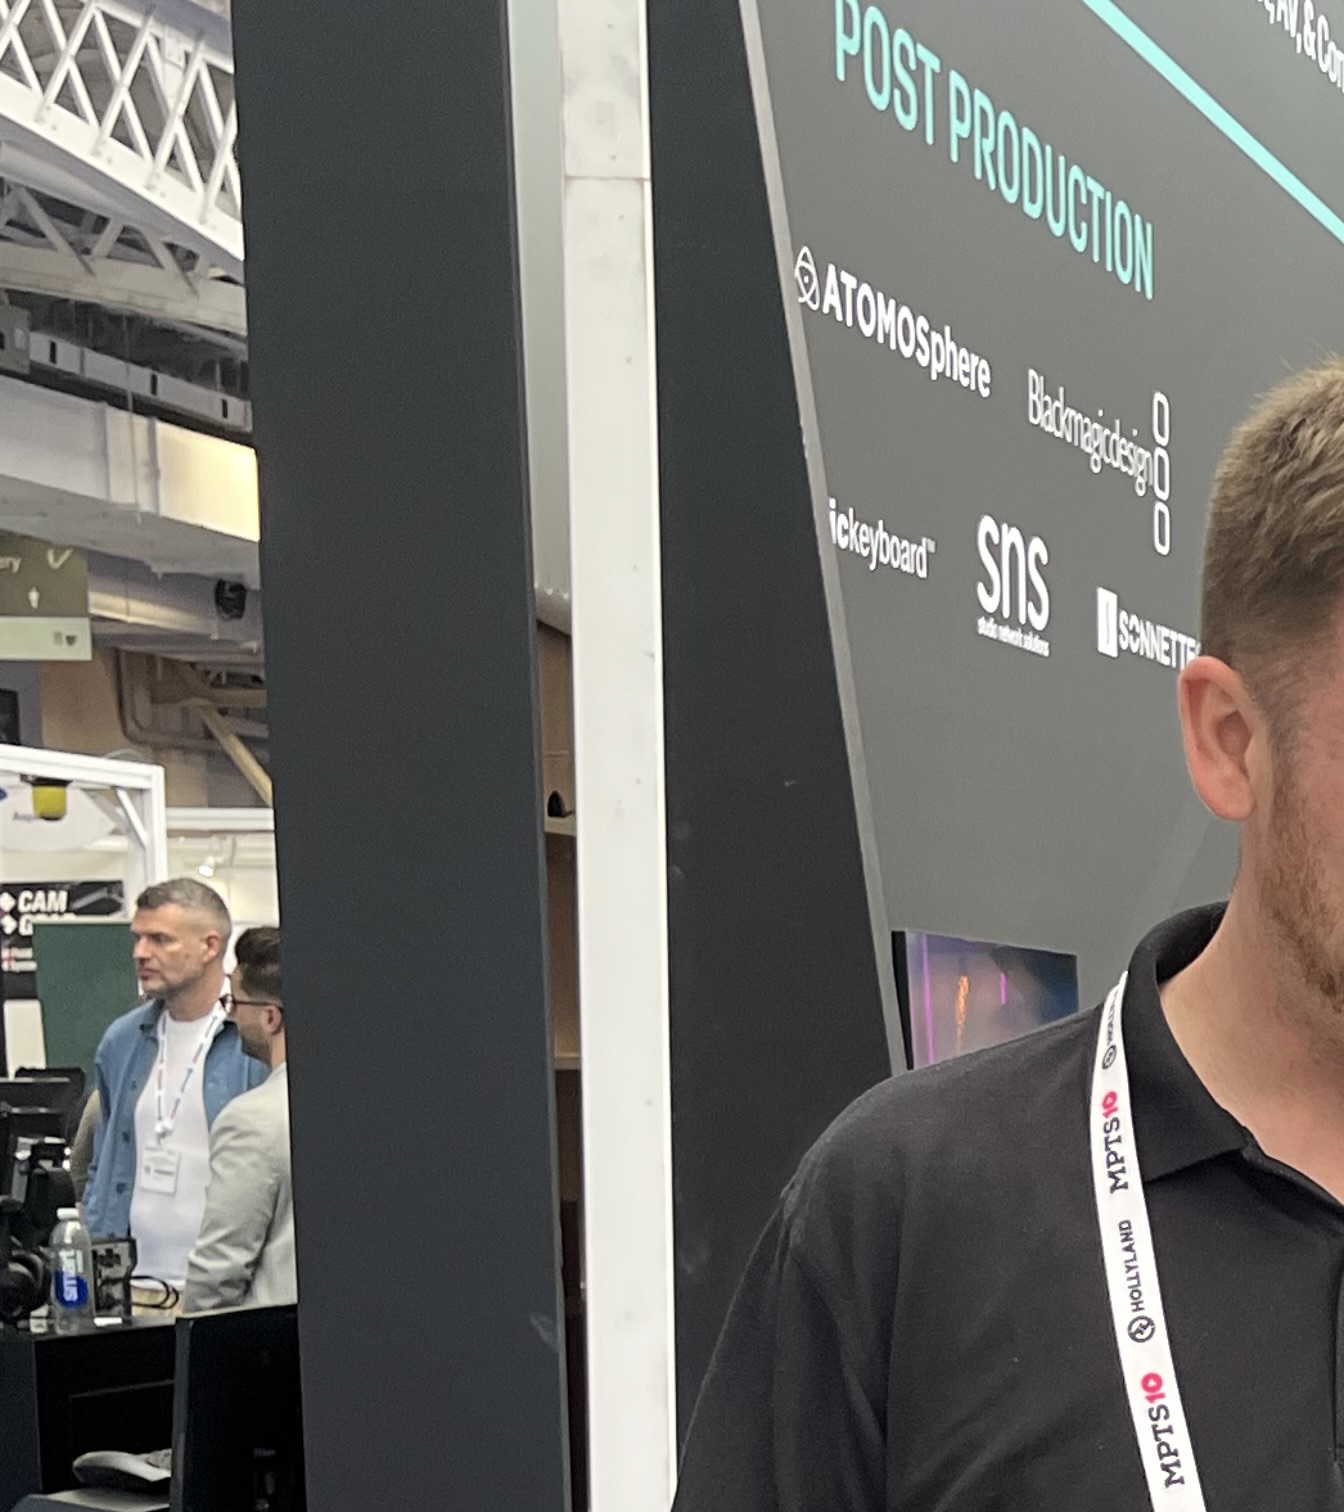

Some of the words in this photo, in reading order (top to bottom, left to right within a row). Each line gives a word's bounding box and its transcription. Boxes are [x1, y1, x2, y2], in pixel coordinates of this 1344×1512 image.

[835, 0, 941, 145] POST
[949, 70, 1153, 300] PRODUCTION
[822, 263, 992, 398] ATOMOSphere
[976, 515, 1050, 631] sns
[18, 890, 68, 913] CAM
[1118, 1219, 1145, 1312] HOLLYLAND
